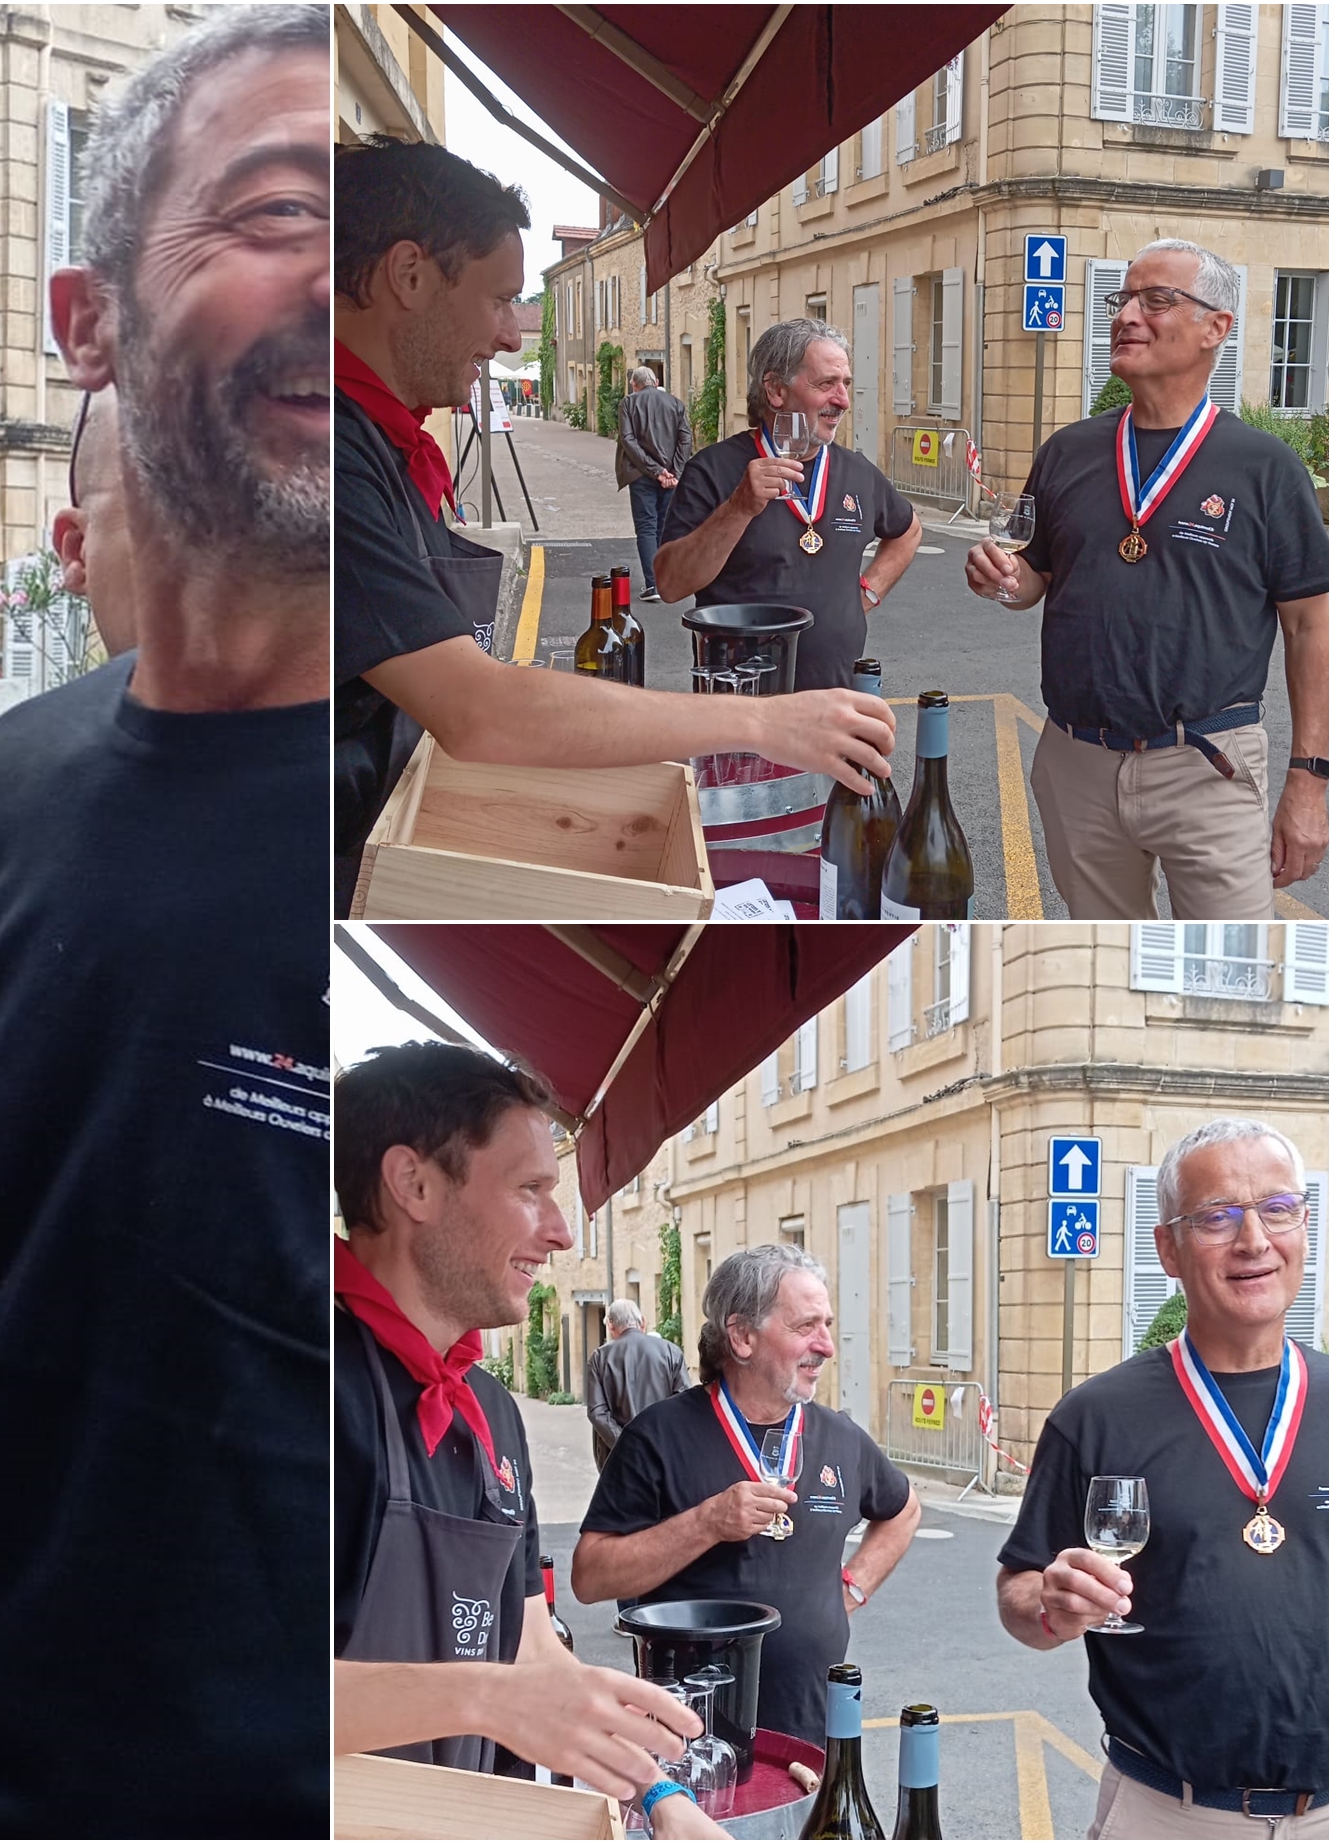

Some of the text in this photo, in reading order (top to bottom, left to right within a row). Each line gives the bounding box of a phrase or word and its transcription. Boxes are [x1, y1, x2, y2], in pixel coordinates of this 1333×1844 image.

[1050, 316, 1059, 324] 20
[229, 1087, 248, 1101] de
[1081, 1239, 1092, 1248] 20
[454, 1646, 476, 1656] VINS
